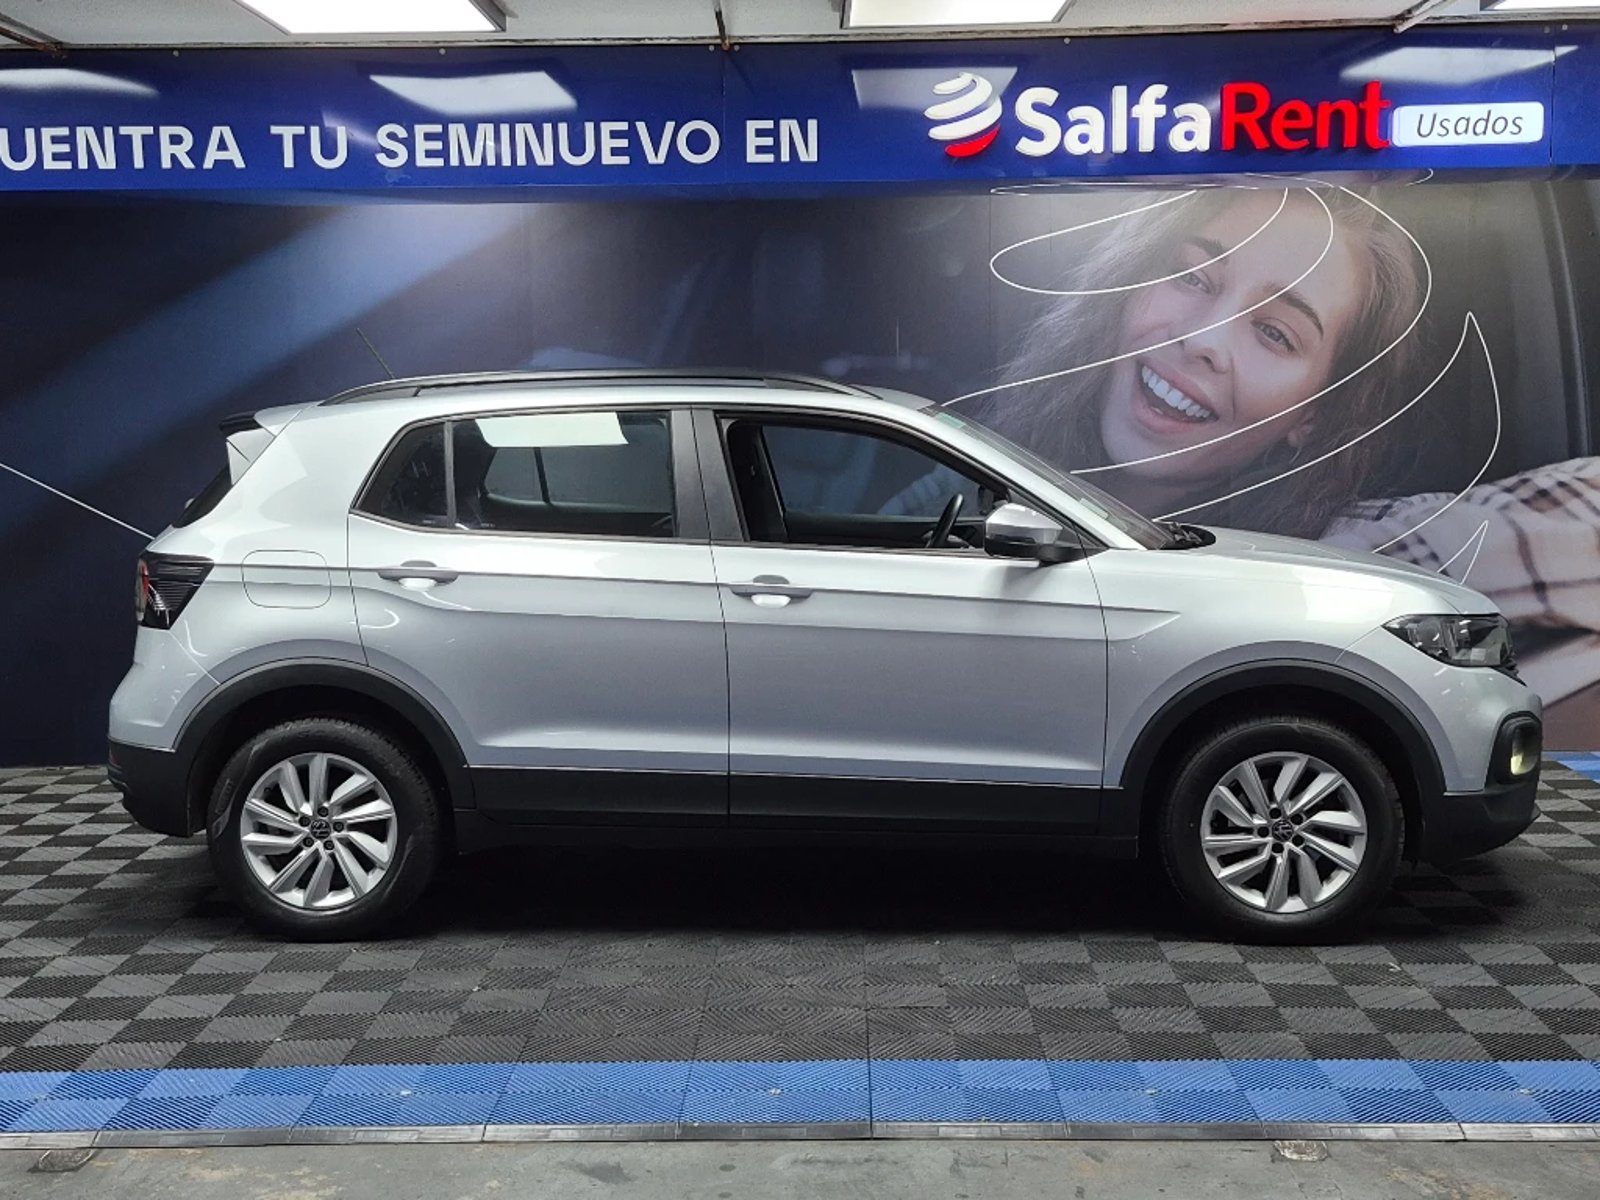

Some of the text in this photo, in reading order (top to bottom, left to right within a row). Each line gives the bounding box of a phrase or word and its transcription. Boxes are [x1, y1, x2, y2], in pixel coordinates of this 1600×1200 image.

[1417, 108, 1524, 138] Usados
[0, 118, 819, 171] UENTRA TU SEMINUEVO EN
